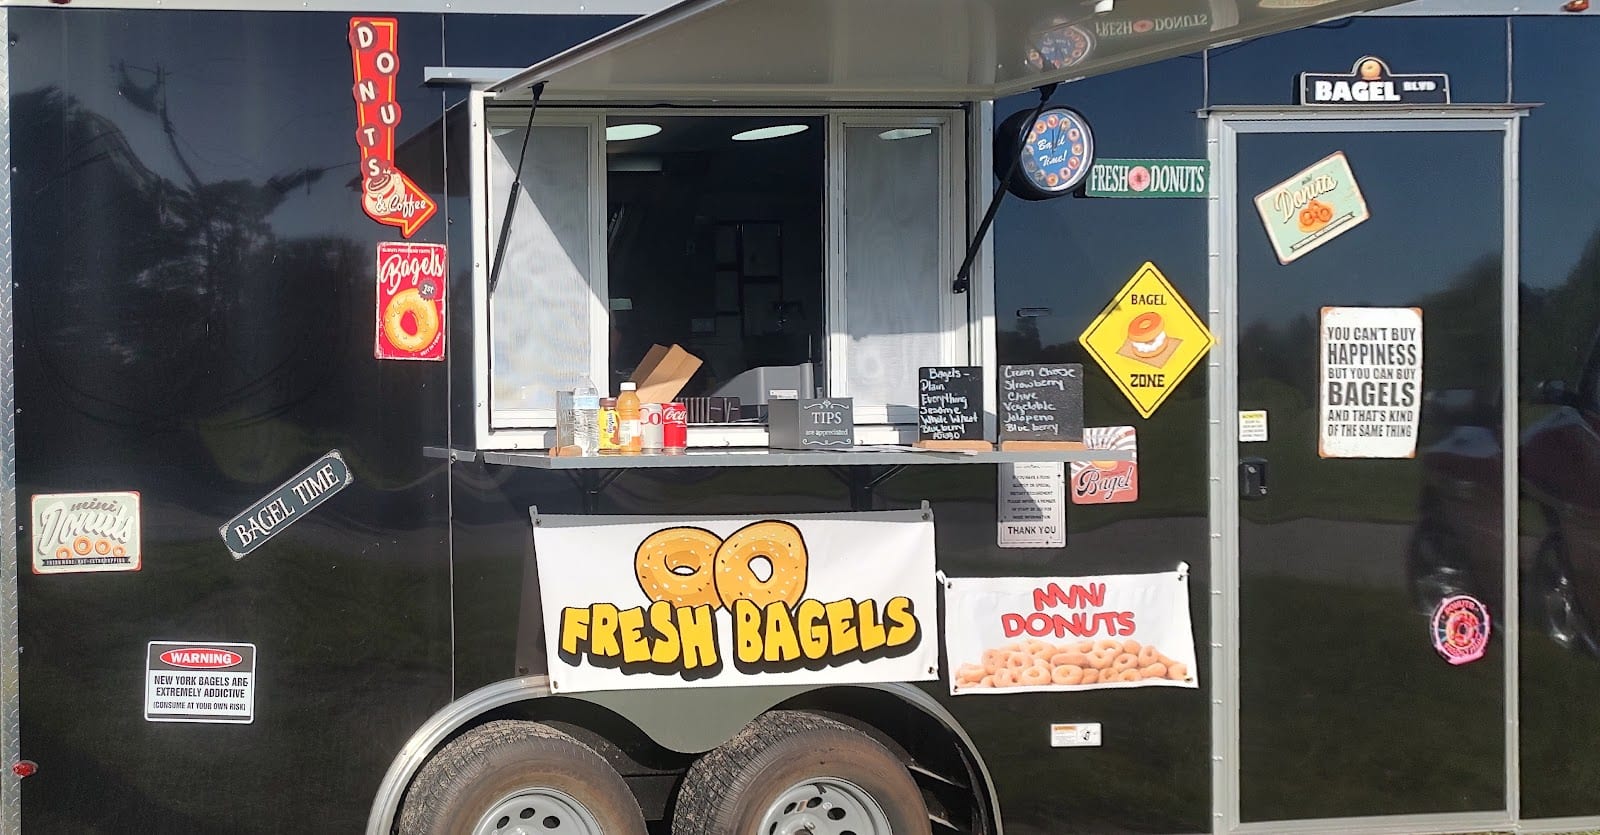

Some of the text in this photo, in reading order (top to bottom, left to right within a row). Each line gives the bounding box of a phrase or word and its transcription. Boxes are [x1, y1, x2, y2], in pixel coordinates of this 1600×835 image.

[1314, 81, 1436, 101] BAGEL BLVD
[357, 26, 396, 176] DONUTS
[1091, 164, 1205, 193] FRESH DONUTS
[389, 194, 426, 218] Coffee
[1274, 175, 1338, 224] Donuts
[380, 247, 444, 295] Bagels
[1131, 294, 1167, 306] BAGEL
[1327, 327, 1416, 341] YOU CAN'T BUY
[1328, 343, 1417, 366] HAPPINESS
[929, 368, 961, 382] Bagels
[1004, 365, 1034, 378] Cream
[1328, 368, 1416, 380] BUT YOU CAN BUY
[920, 379, 945, 391] Plain
[1004, 380, 1065, 390] Strawberry
[1130, 374, 1165, 387] ZONE
[921, 393, 968, 409] Everything
[1328, 382, 1415, 407] BAGELS
[920, 406, 962, 414] Sesame
[1003, 401, 1056, 415] Vegetable
[812, 412, 842, 424] TIPS
[1328, 410, 1413, 422] AND THAT'S KIND
[1328, 425, 1412, 437] OF THE SAME THING
[1077, 467, 1133, 500] Bagel
[234, 463, 340, 547] BAGEL TIME
[1008, 526, 1057, 535] THANK YOU
[1033, 582, 1106, 611] MINI
[1001, 611, 1136, 638] DONUTS
[559, 597, 921, 680] FRESH BAGELS
[170, 653, 231, 664] WARNING
[154, 676, 248, 687] NEW YORK BAGELS ARE
[156, 687, 245, 698] EXTREMELY ADDICTIVE
[196, 702, 211, 710] YOUR
